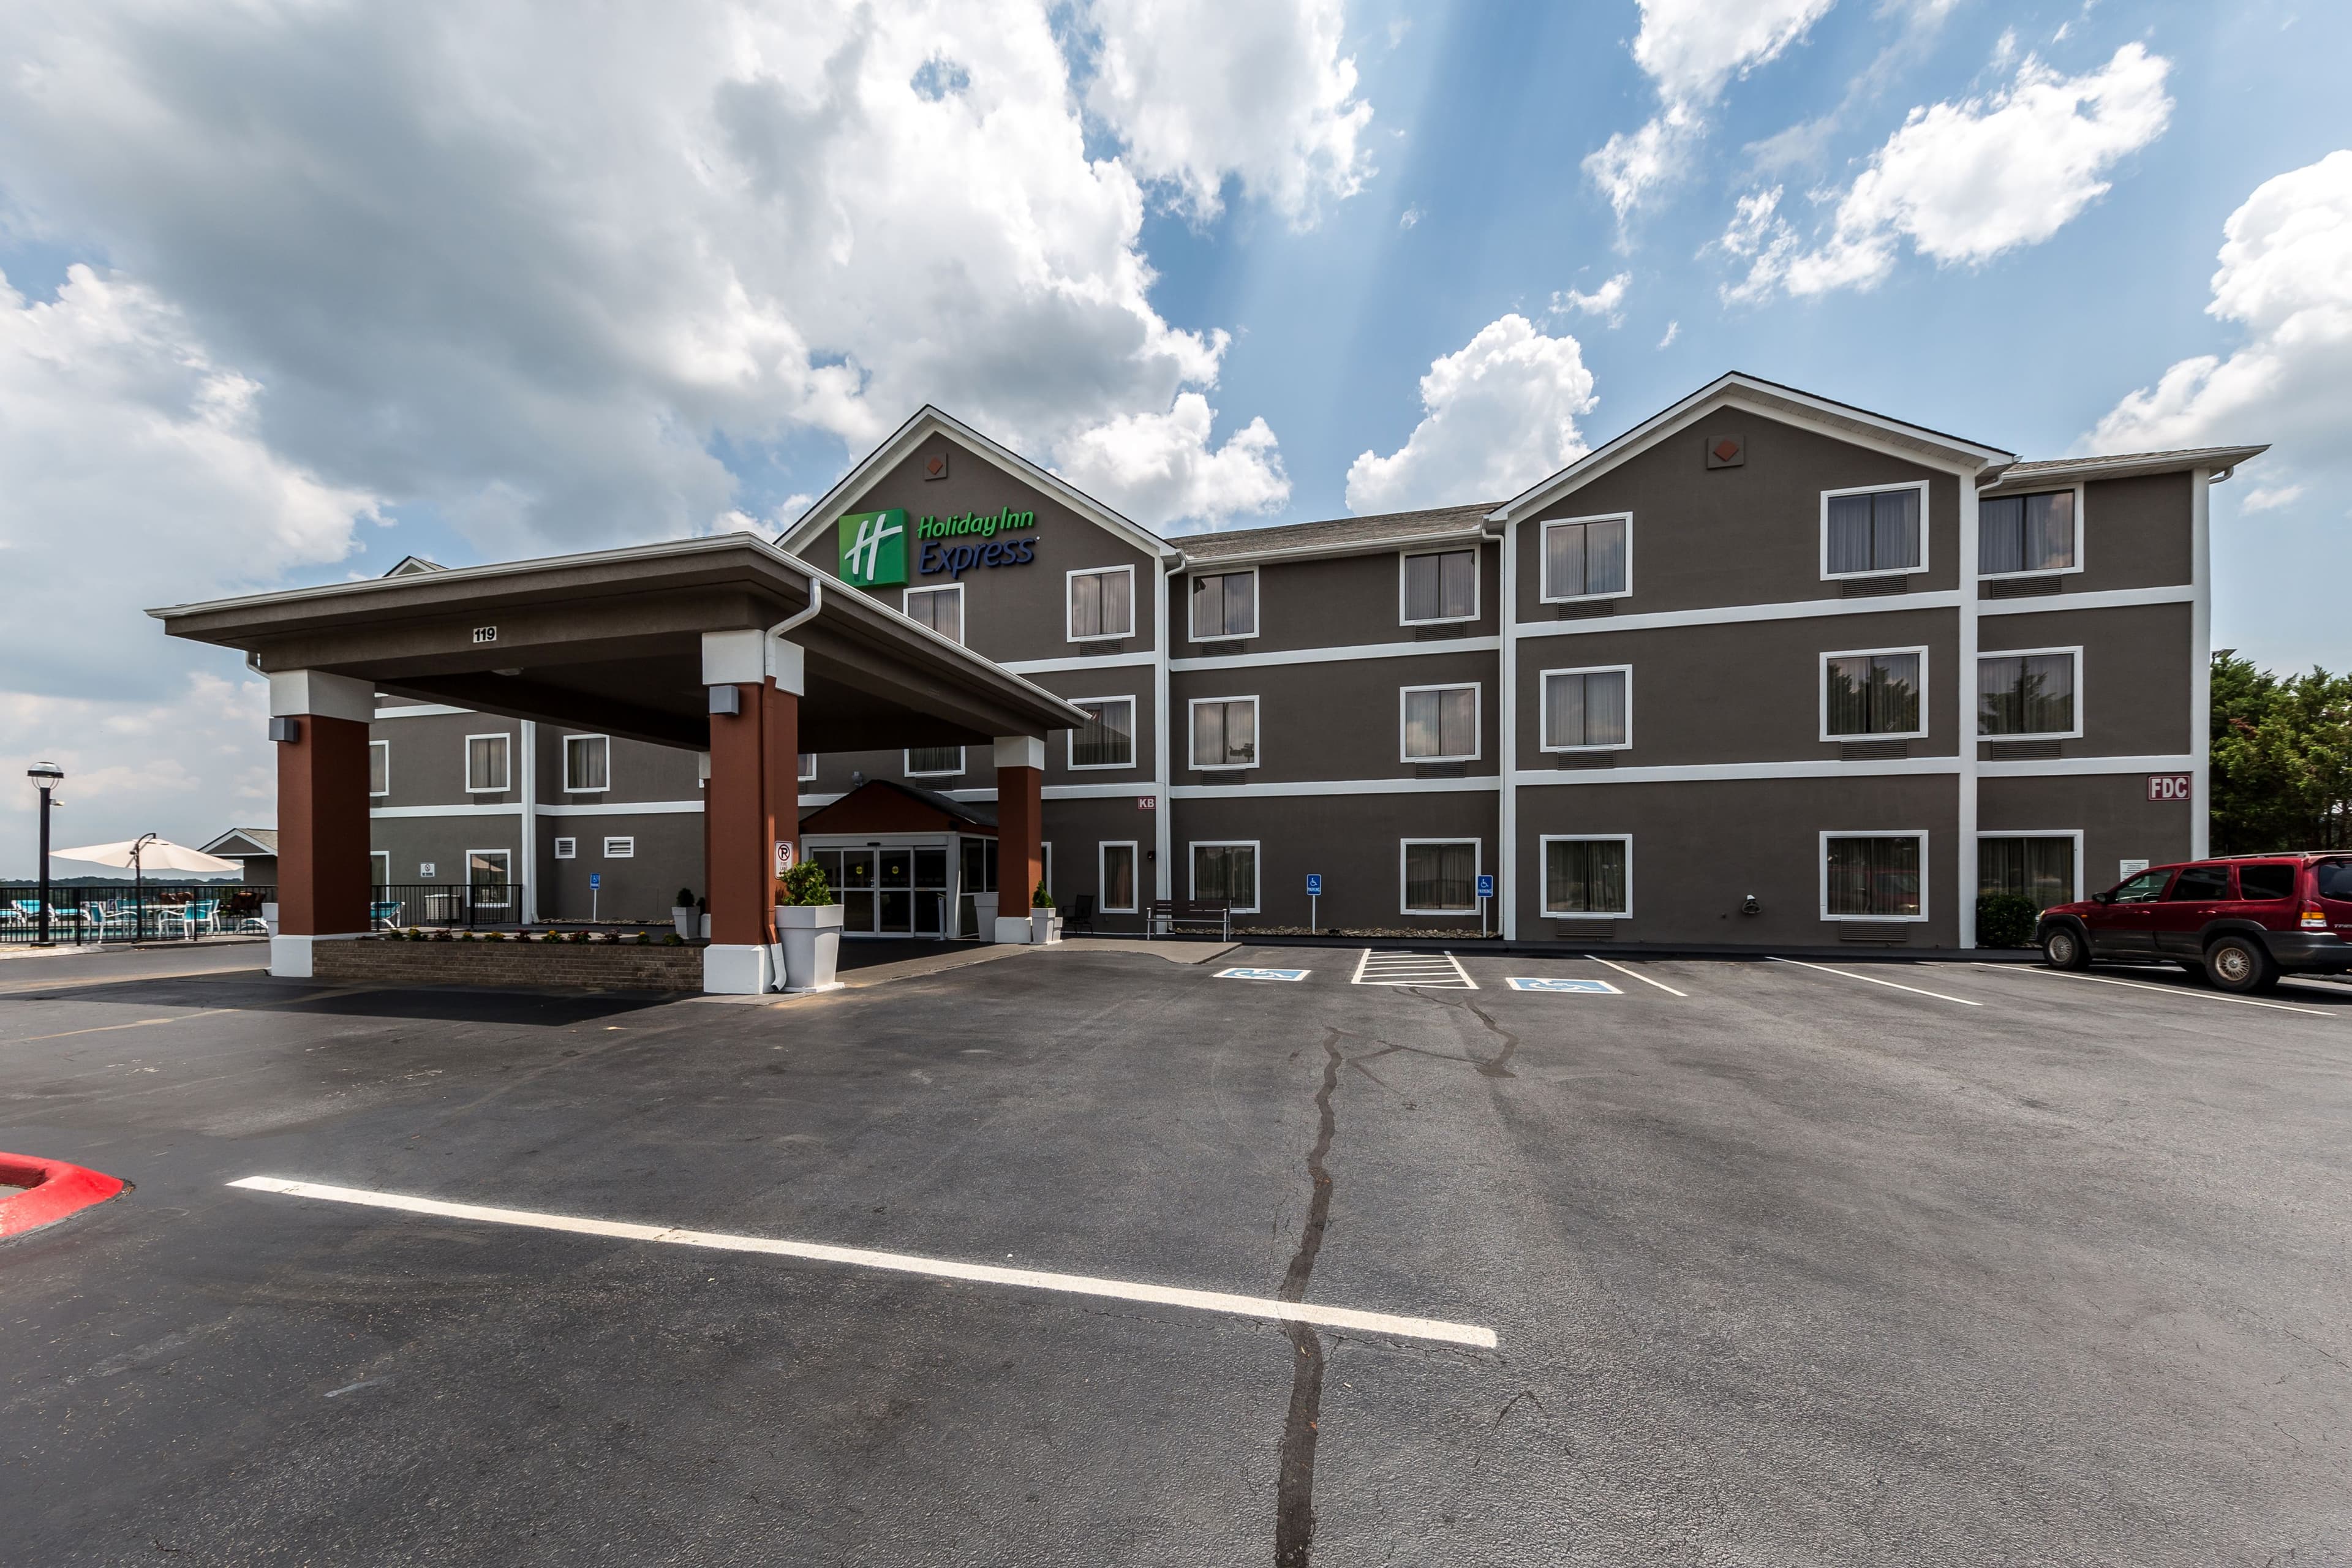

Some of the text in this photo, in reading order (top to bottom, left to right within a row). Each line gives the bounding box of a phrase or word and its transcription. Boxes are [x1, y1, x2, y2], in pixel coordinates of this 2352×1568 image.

[916, 506, 1034, 539] Holiday Inn
[845, 513, 903, 581] H
[919, 537, 1036, 579] Express
[475, 627, 496, 642] 119
[2151, 777, 2187, 798] FDC
[1139, 798, 1155, 808] KB
